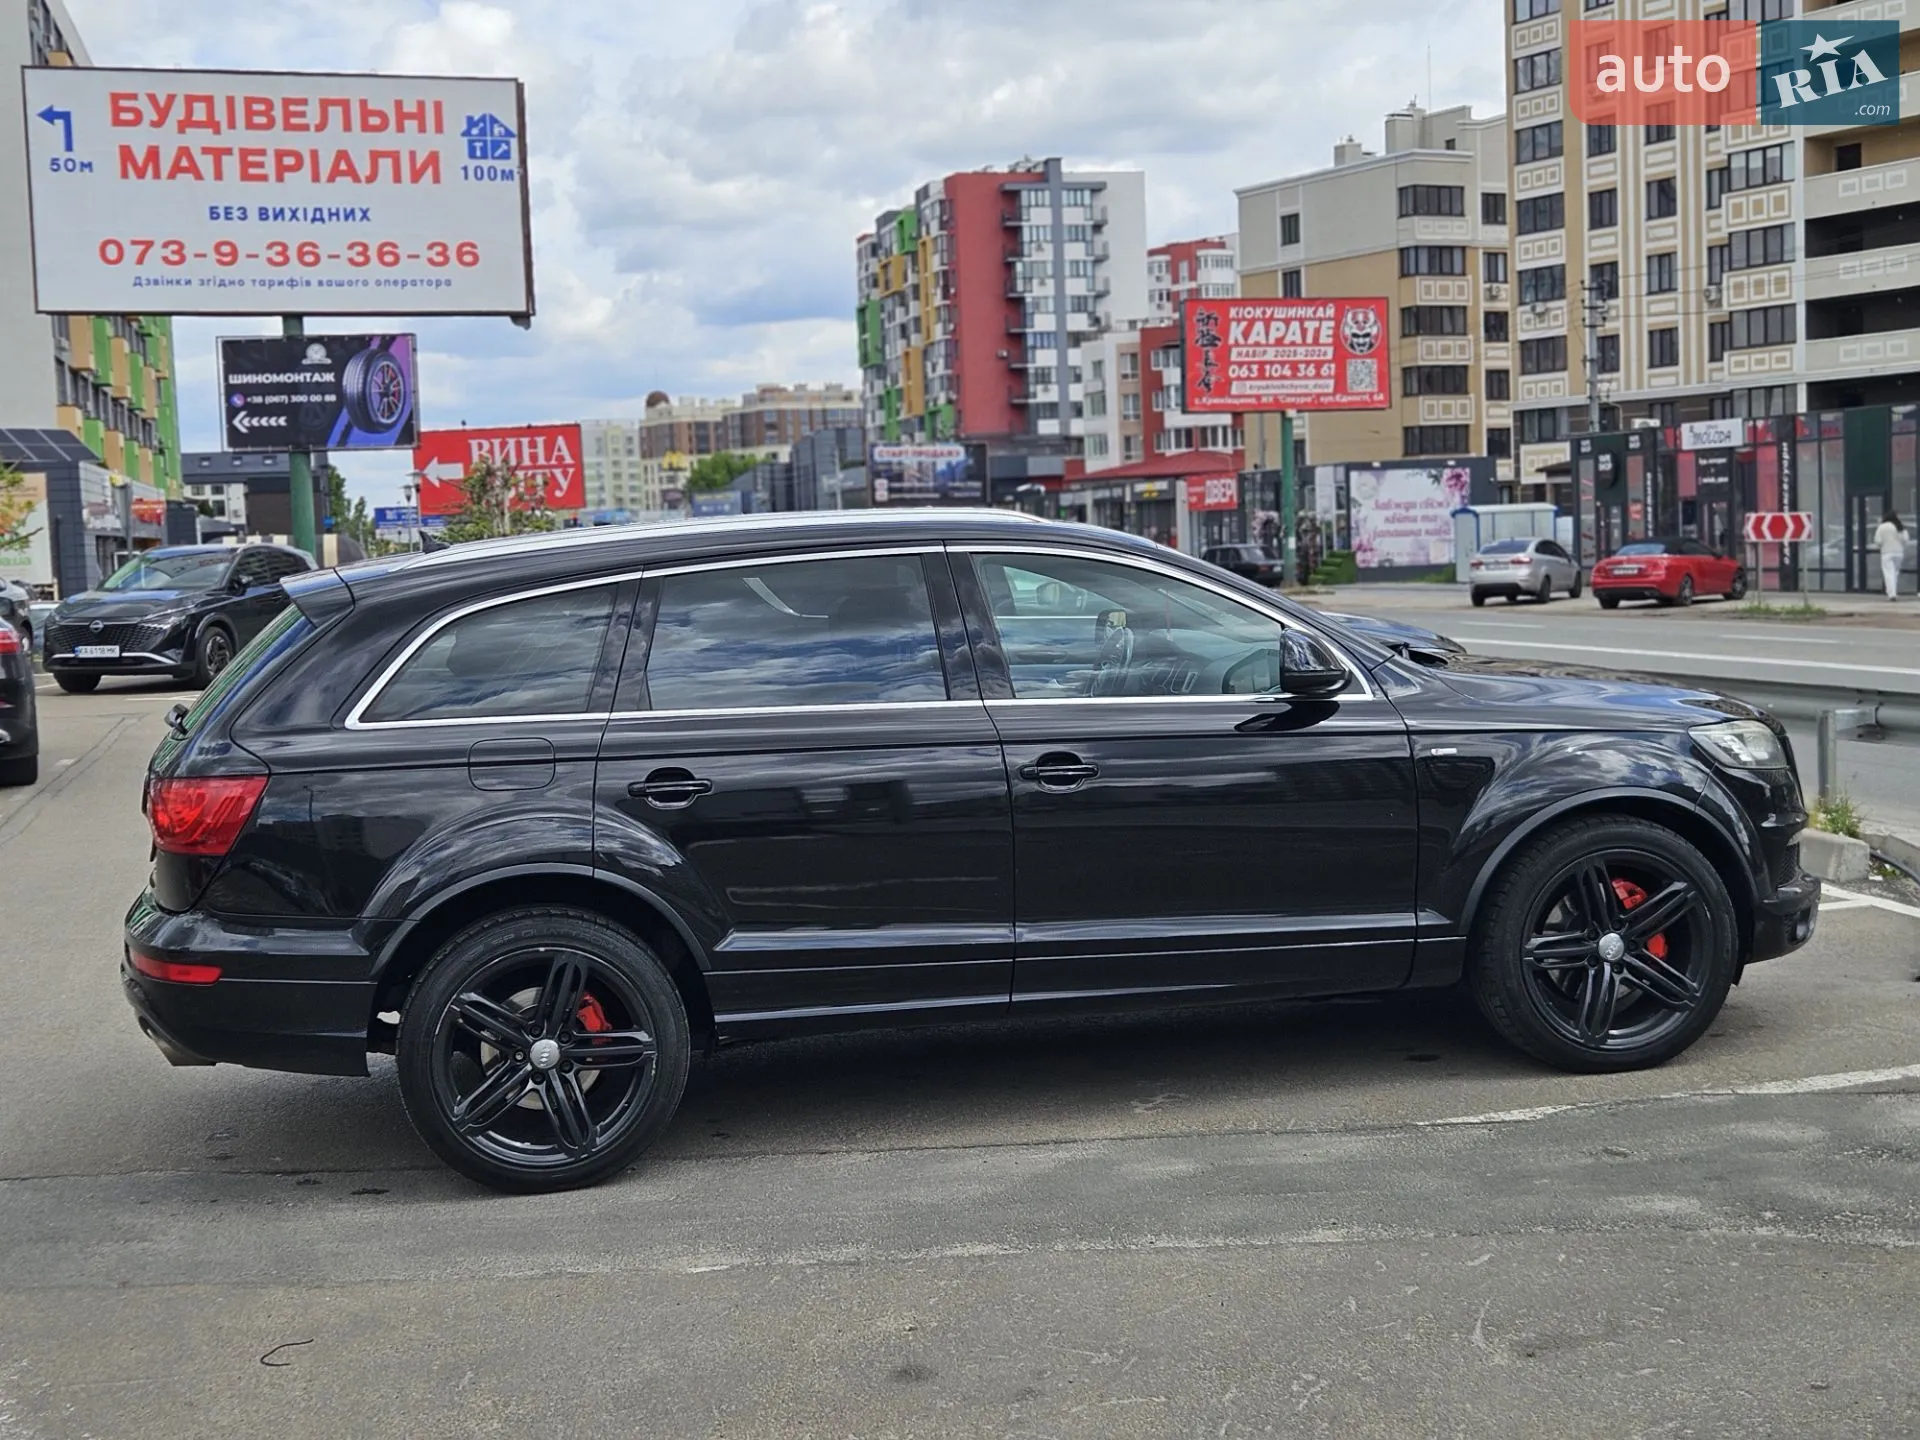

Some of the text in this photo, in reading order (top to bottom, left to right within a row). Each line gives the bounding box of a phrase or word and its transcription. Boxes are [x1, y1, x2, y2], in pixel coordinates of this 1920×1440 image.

[109, 91, 444, 136] БУДІВЕЛЬНІ
[49, 157, 93, 173] 50м
[118, 143, 442, 185] МАТЕРІАЛИ
[461, 165, 515, 182] 100м
[208, 205, 372, 225] БЕЗ ВИХІДНИХ
[98, 238, 480, 268] 073-9-36-36-36
[132, 275, 452, 290] Дзвінки згідно тарифів вашого оператора
[1228, 304, 1336, 320] КІОКУШИНКАЙ
[1228, 320, 1336, 345] КАРАТЕ
[1236, 348, 1268, 359] НАБІР
[1228, 362, 1335, 378] 063 104 36 61
[228, 372, 336, 385] ШИНОМОНТАЖ
[247, 395, 263, 404] +38
[309, 394, 322, 403] 00
[468, 435, 576, 468] ВИНА
